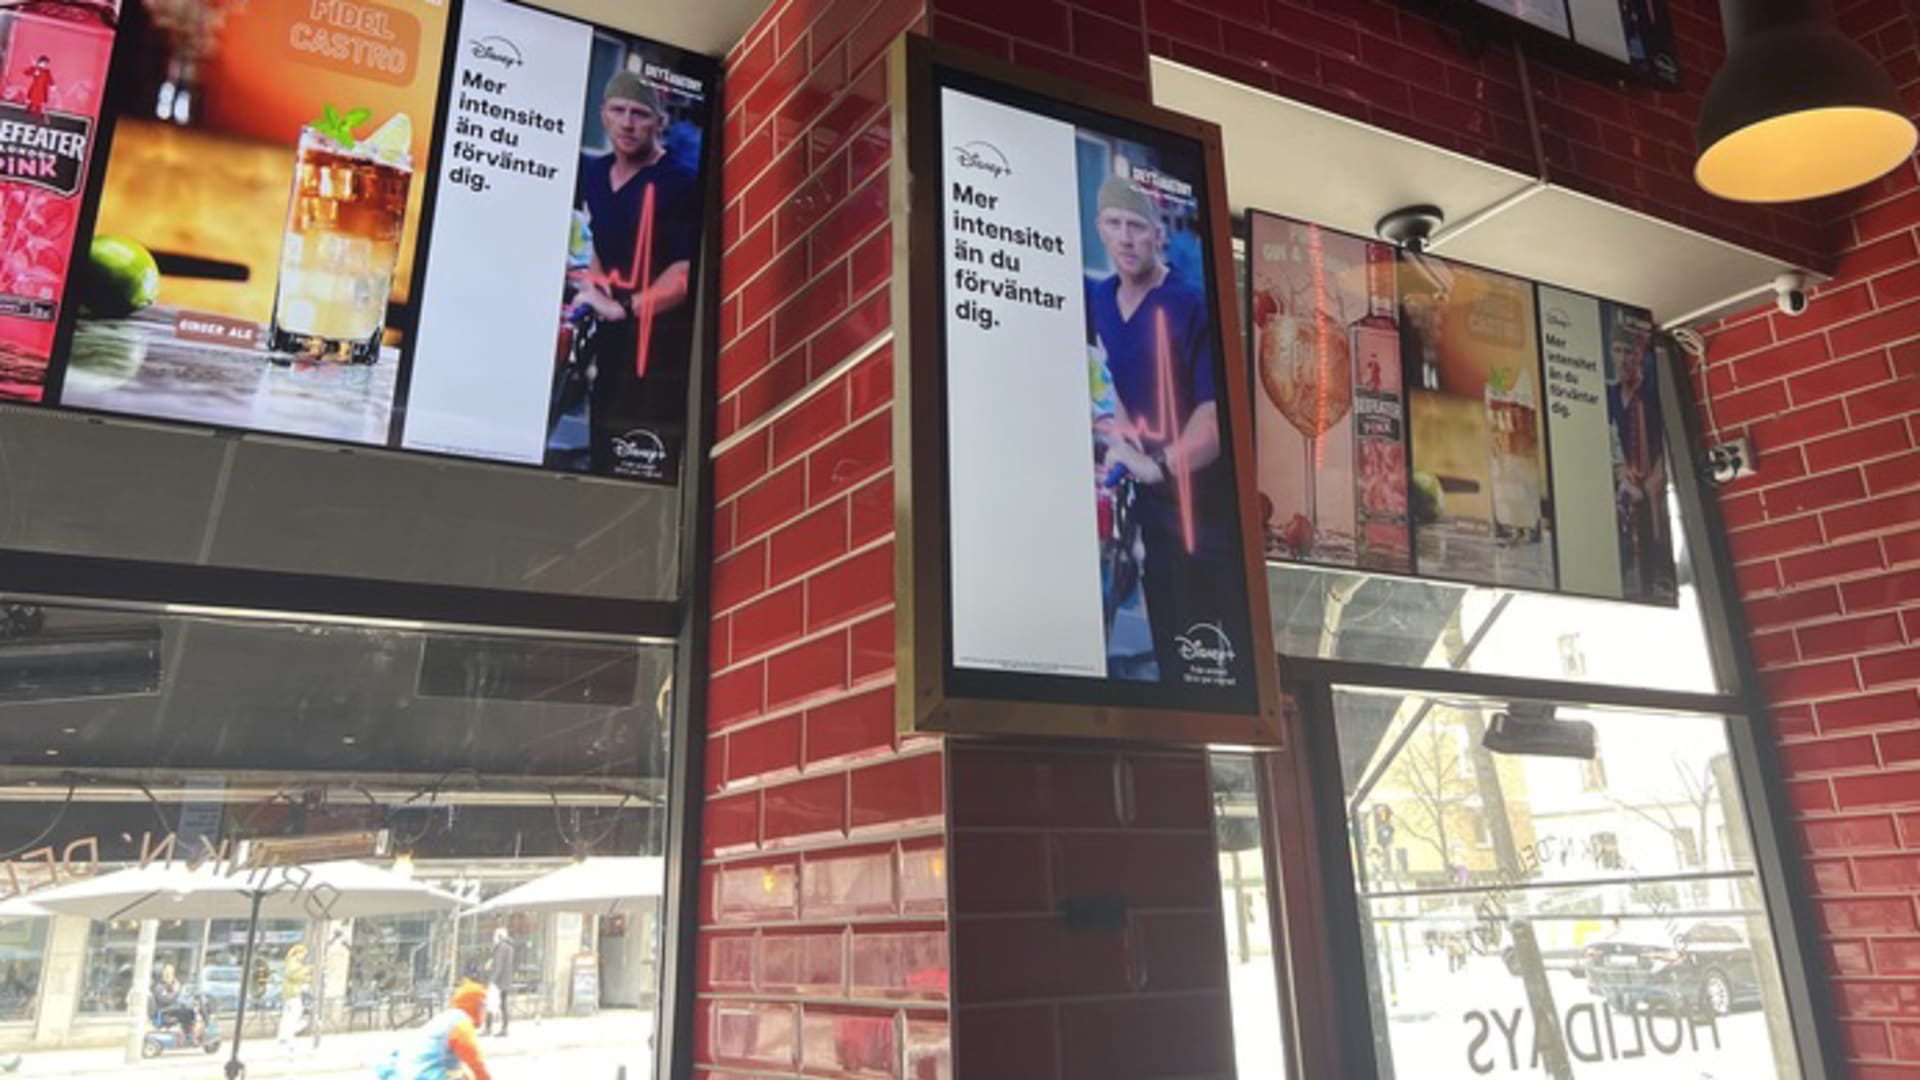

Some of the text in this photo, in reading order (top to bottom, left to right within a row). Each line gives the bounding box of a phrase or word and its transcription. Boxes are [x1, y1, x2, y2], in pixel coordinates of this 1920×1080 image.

[310, 0, 395, 40] FIDEL
[290, 22, 407, 74] CASTRO
[462, 69, 507, 95] Mer
[455, 115, 519, 148] än du
[459, 91, 566, 135] intensitet
[0, 121, 87, 163] EFEATER
[452, 140, 560, 181] förväntar
[448, 165, 491, 193] dig.
[952, 181, 999, 210] Mer
[952, 210, 1065, 256] intensitet
[954, 238, 1020, 273] än du
[954, 268, 1067, 311] förväntar
[227, 326, 253, 339] ALE
[955, 299, 1000, 331] dig.
[1545, 332, 1566, 348] Mer
[1174, 623, 1236, 667] Disney+
